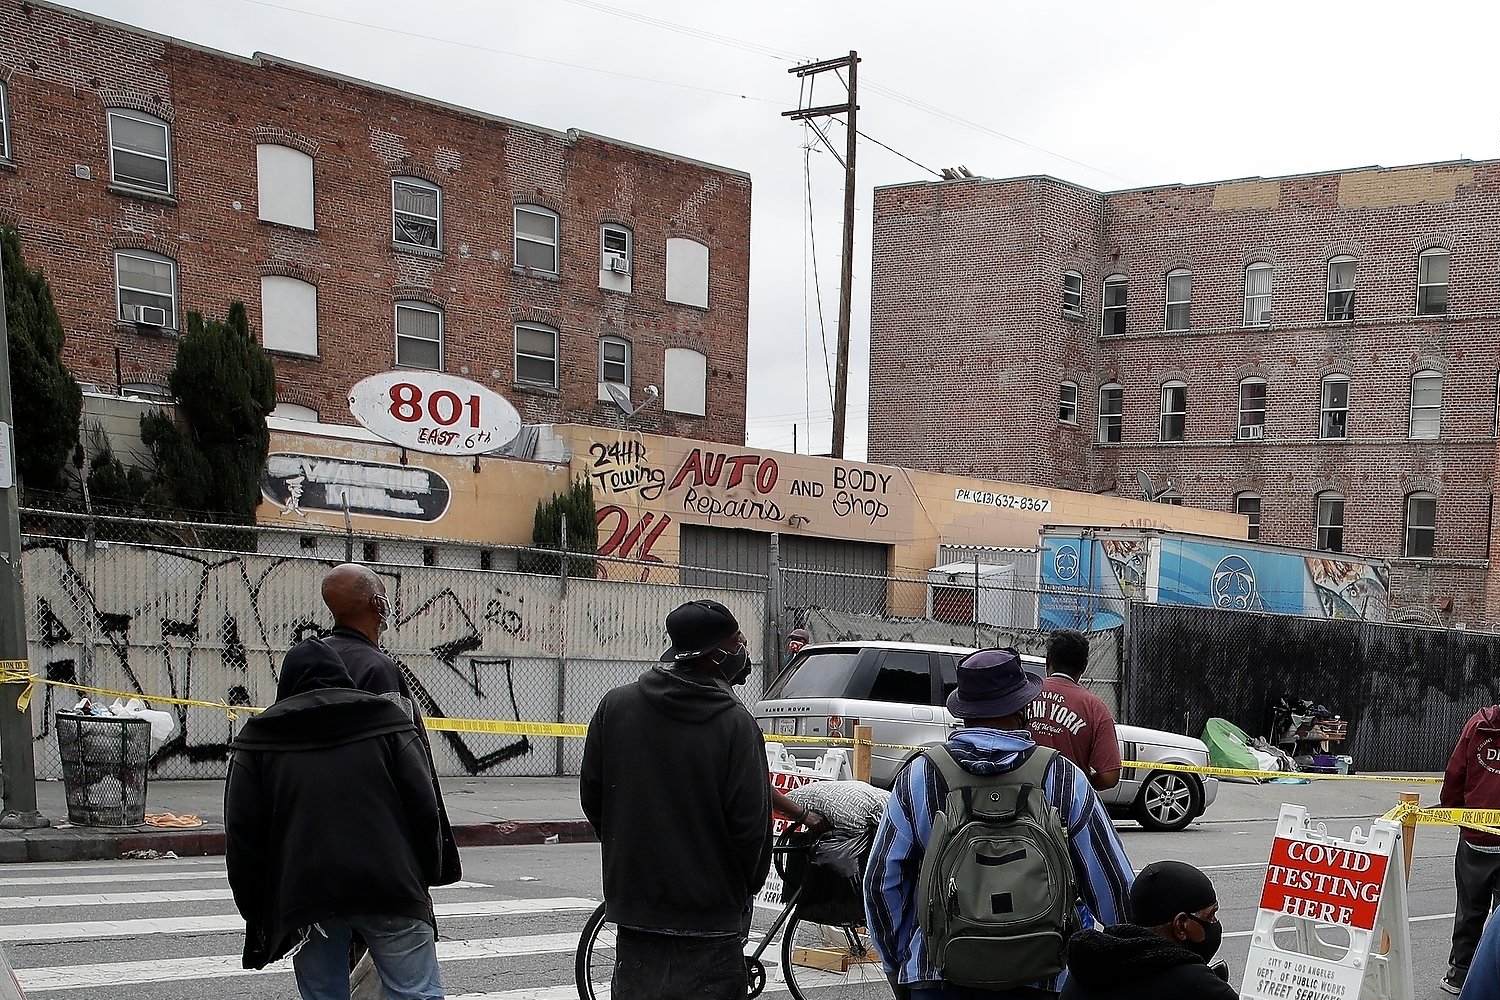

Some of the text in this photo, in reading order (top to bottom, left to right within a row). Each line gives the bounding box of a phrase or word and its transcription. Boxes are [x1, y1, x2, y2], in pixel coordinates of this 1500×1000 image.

[389, 383, 480, 428] 801
[464, 430, 491, 449] 6th
[590, 440, 779, 494] 24HR AUTO
[592, 465, 665, 500] Towing
[790, 466, 893, 498] AND BODY
[832, 490, 889, 526] Shop
[1050, 703, 1087, 735] YORK
[1473, 812, 1484, 823] LINE
[1485, 812, 1492, 823] DO
[1287, 841, 1372, 872] COVID
[1268, 865, 1380, 903] TESTING
[1281, 895, 1354, 926] HERE
[1267, 957, 1335, 980] CITY OF LOS ANGELES
[1256, 978, 1293, 1000] STREET
[1280, 972, 1290, 984] OF
[1292, 974, 1318, 990] PUBLIC
[1320, 980, 1346, 997] WORKS
